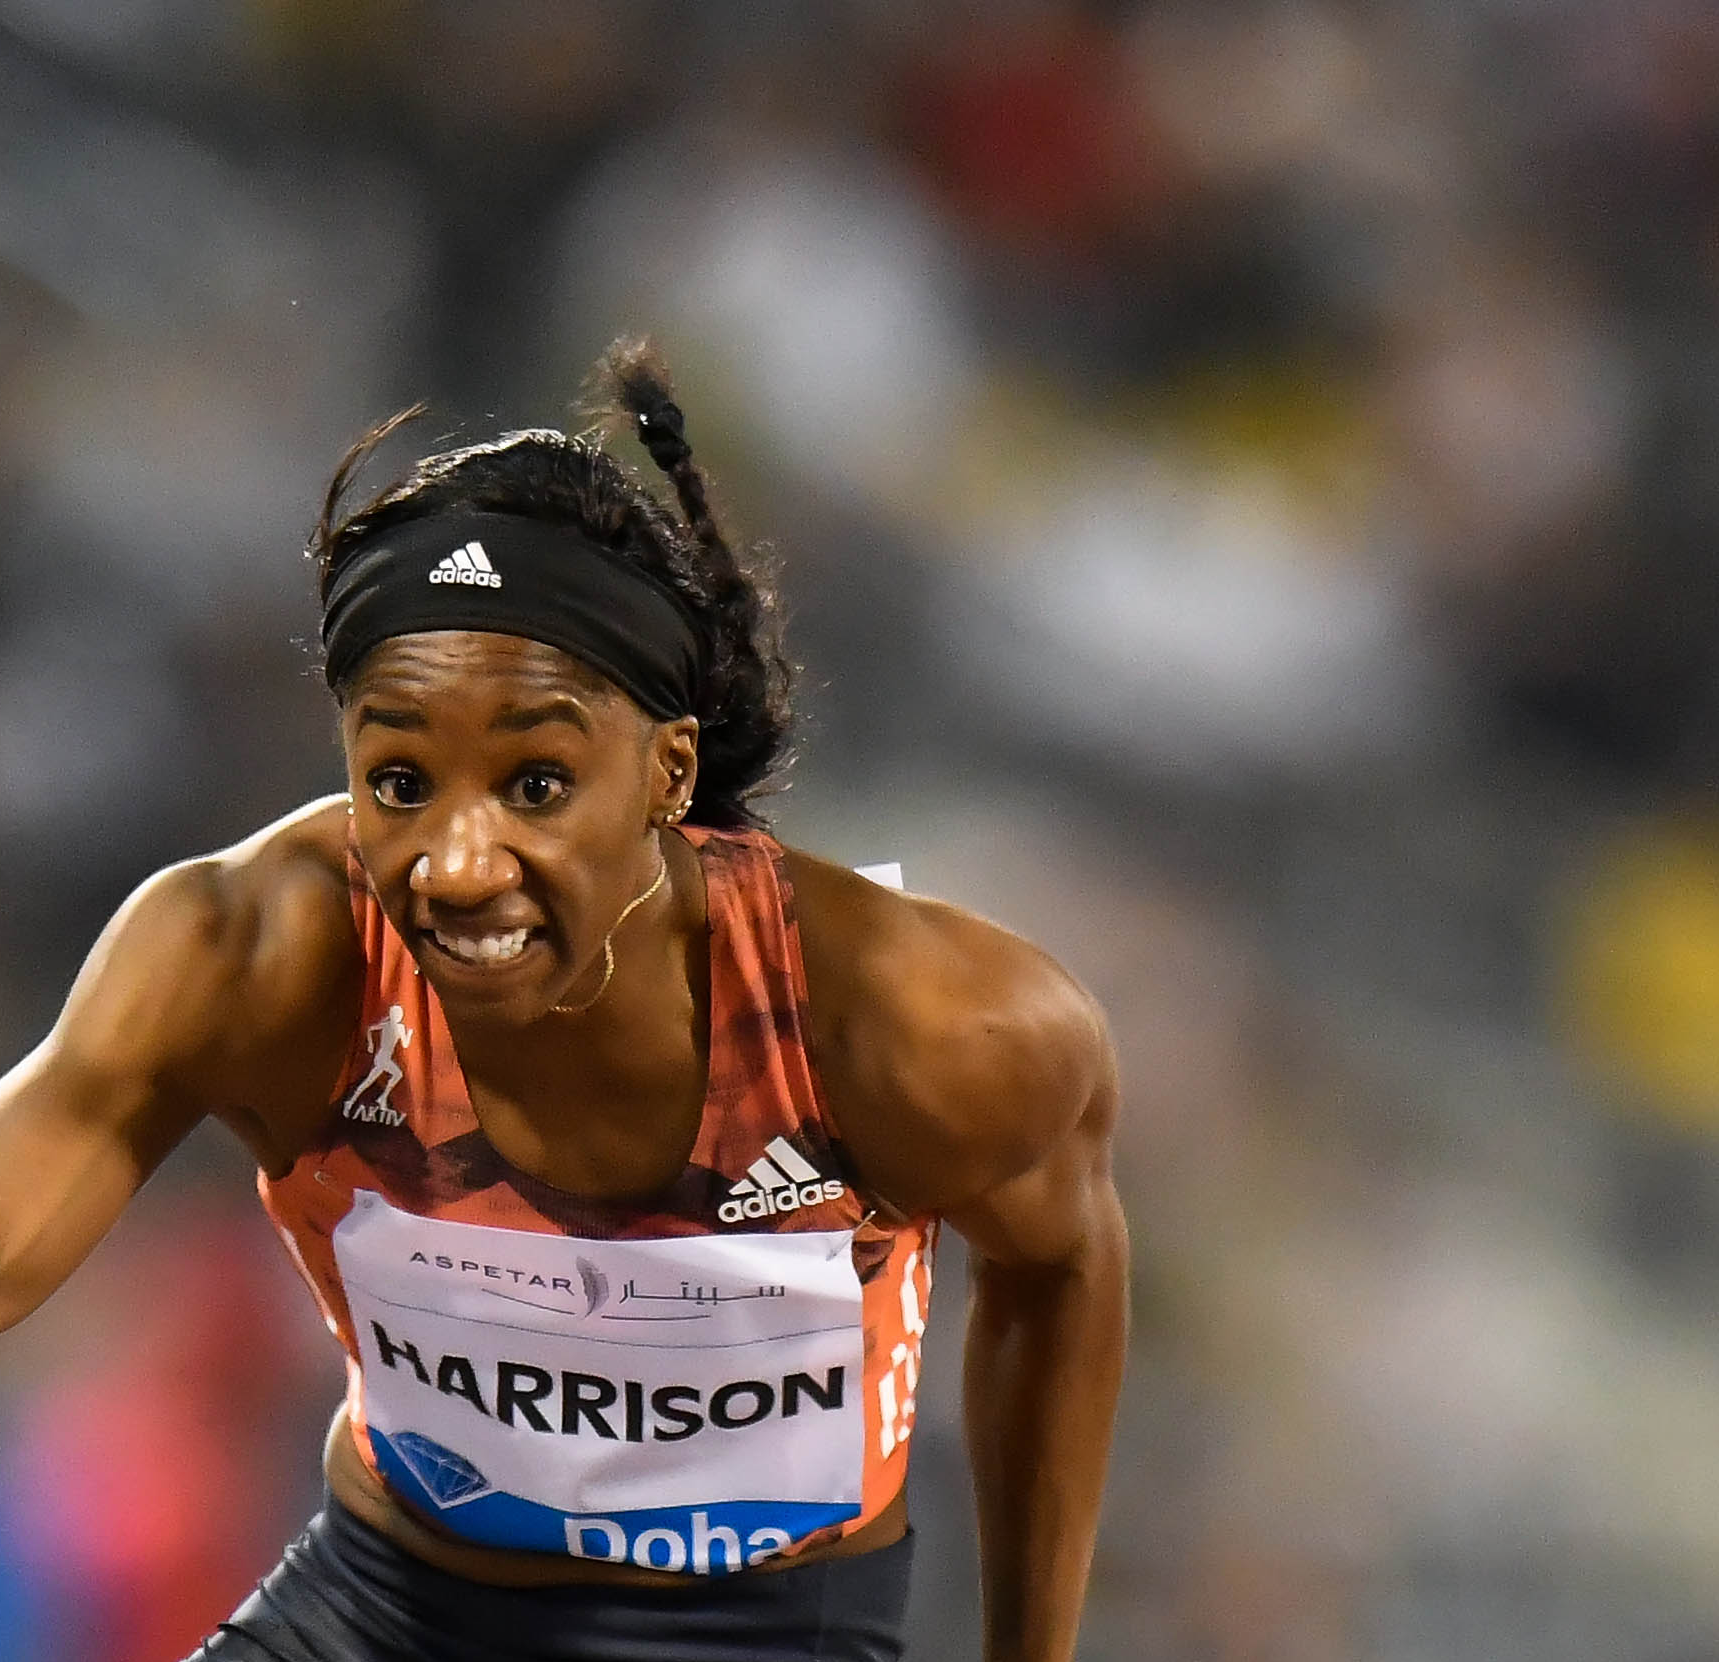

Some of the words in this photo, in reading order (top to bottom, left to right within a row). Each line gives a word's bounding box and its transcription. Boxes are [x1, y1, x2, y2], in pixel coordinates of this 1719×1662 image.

[428, 567, 502, 589] adidas
[717, 1179, 845, 1224] adidas
[409, 1250, 575, 1297] ASPETAR
[370, 1319, 847, 1445] HARRISON
[564, 1511, 793, 1576] Doha
